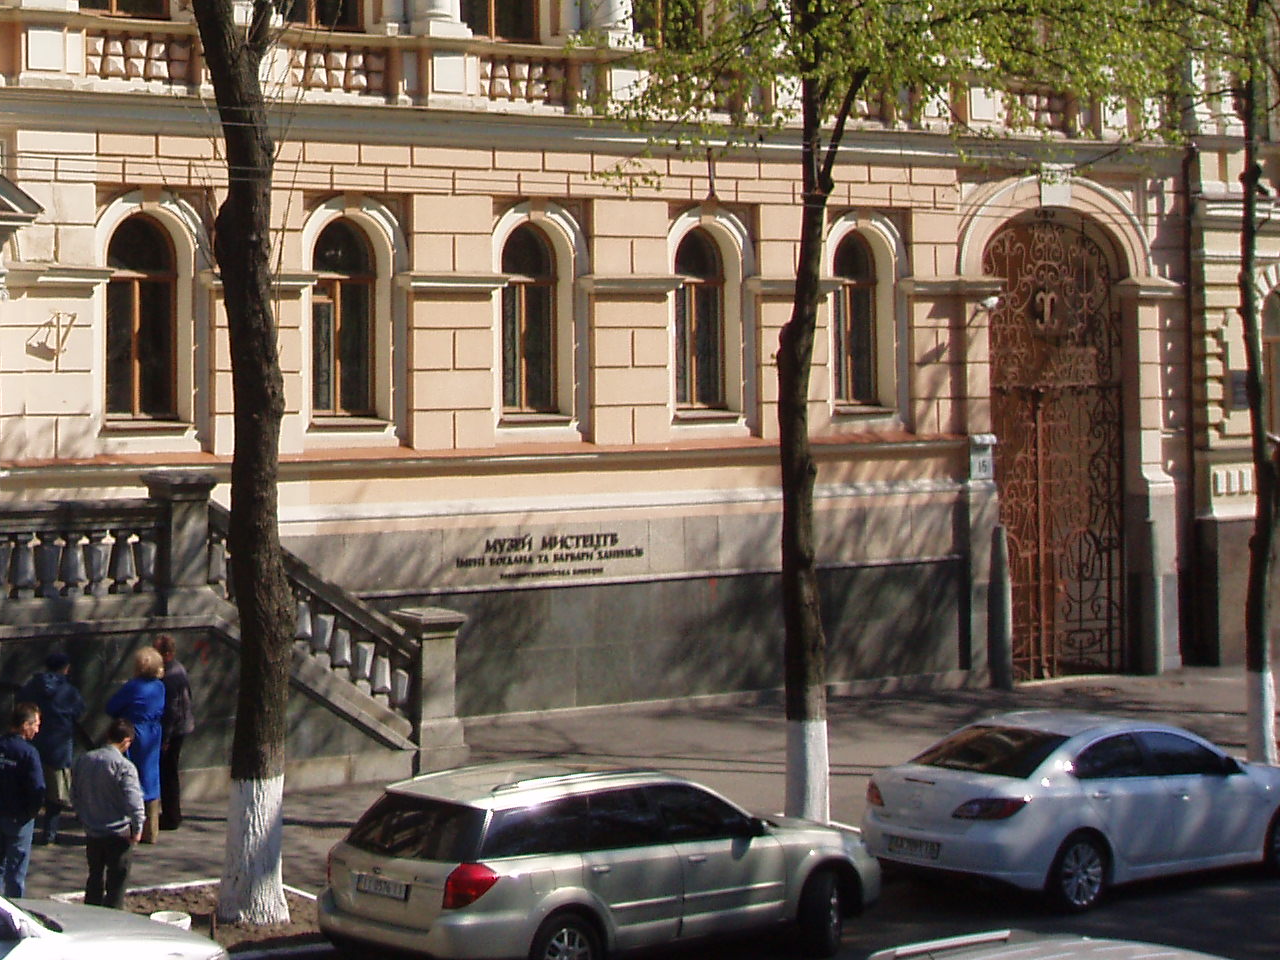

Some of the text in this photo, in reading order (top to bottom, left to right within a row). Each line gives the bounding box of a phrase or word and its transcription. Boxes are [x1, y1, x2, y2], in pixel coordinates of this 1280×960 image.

[483, 532, 619, 554] МУЗЕЙ МИСТЕЦТВ
[537, 553, 549, 564] ТА
